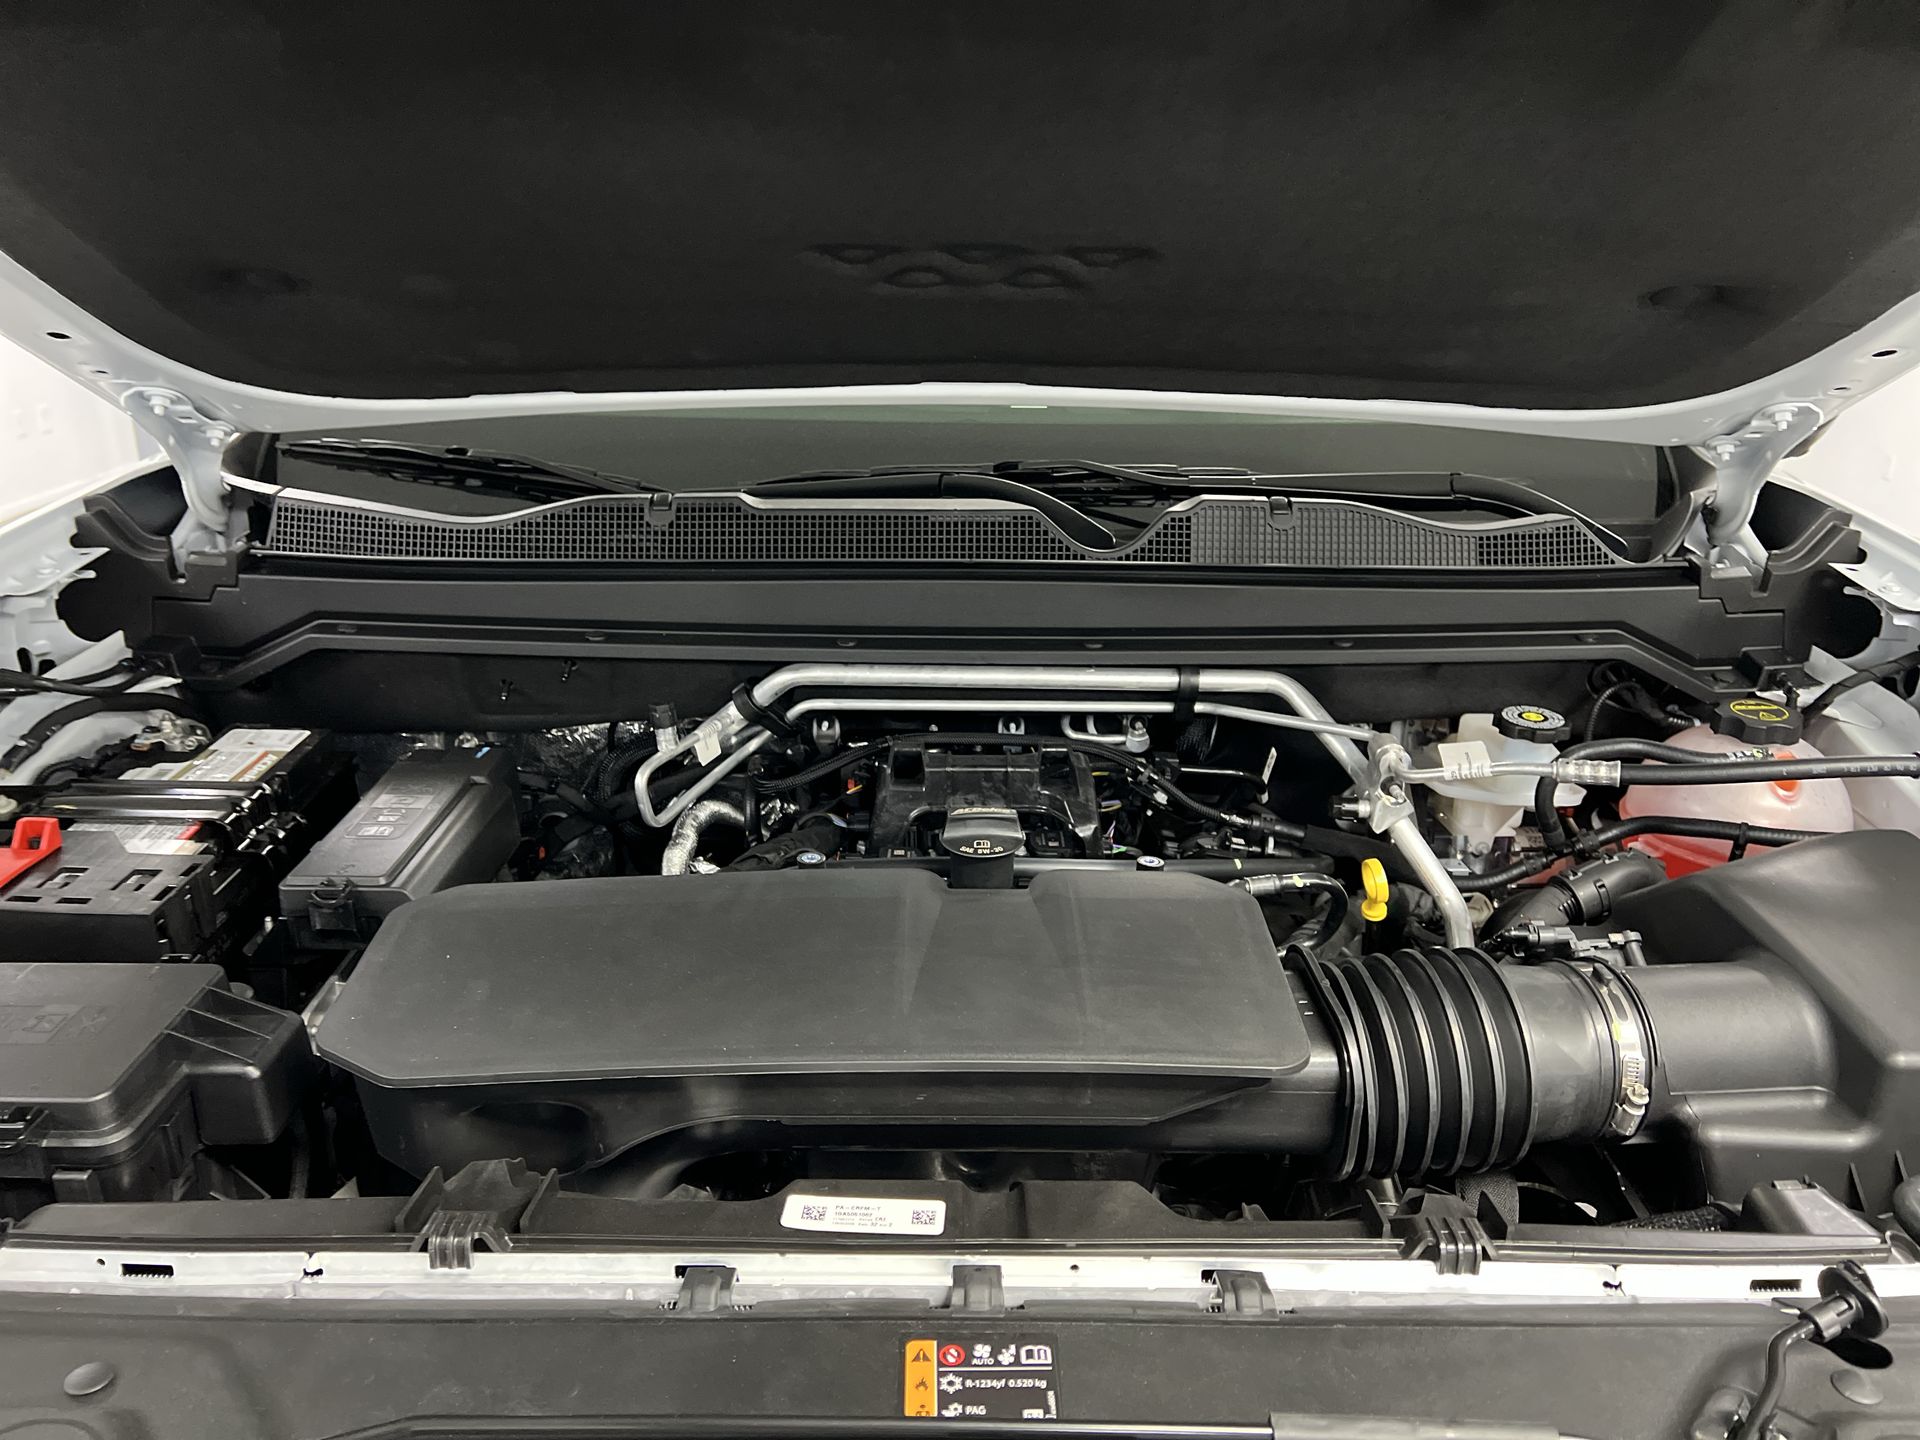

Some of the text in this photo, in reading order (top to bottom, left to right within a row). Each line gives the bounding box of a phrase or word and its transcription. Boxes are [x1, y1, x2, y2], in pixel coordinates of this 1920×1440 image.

[960, 846, 975, 854] SAE
[965, 1379, 1005, 1389] R-1234yf
[1034, 1379, 1047, 1389] kg
[965, 1405, 987, 1415] PAG
